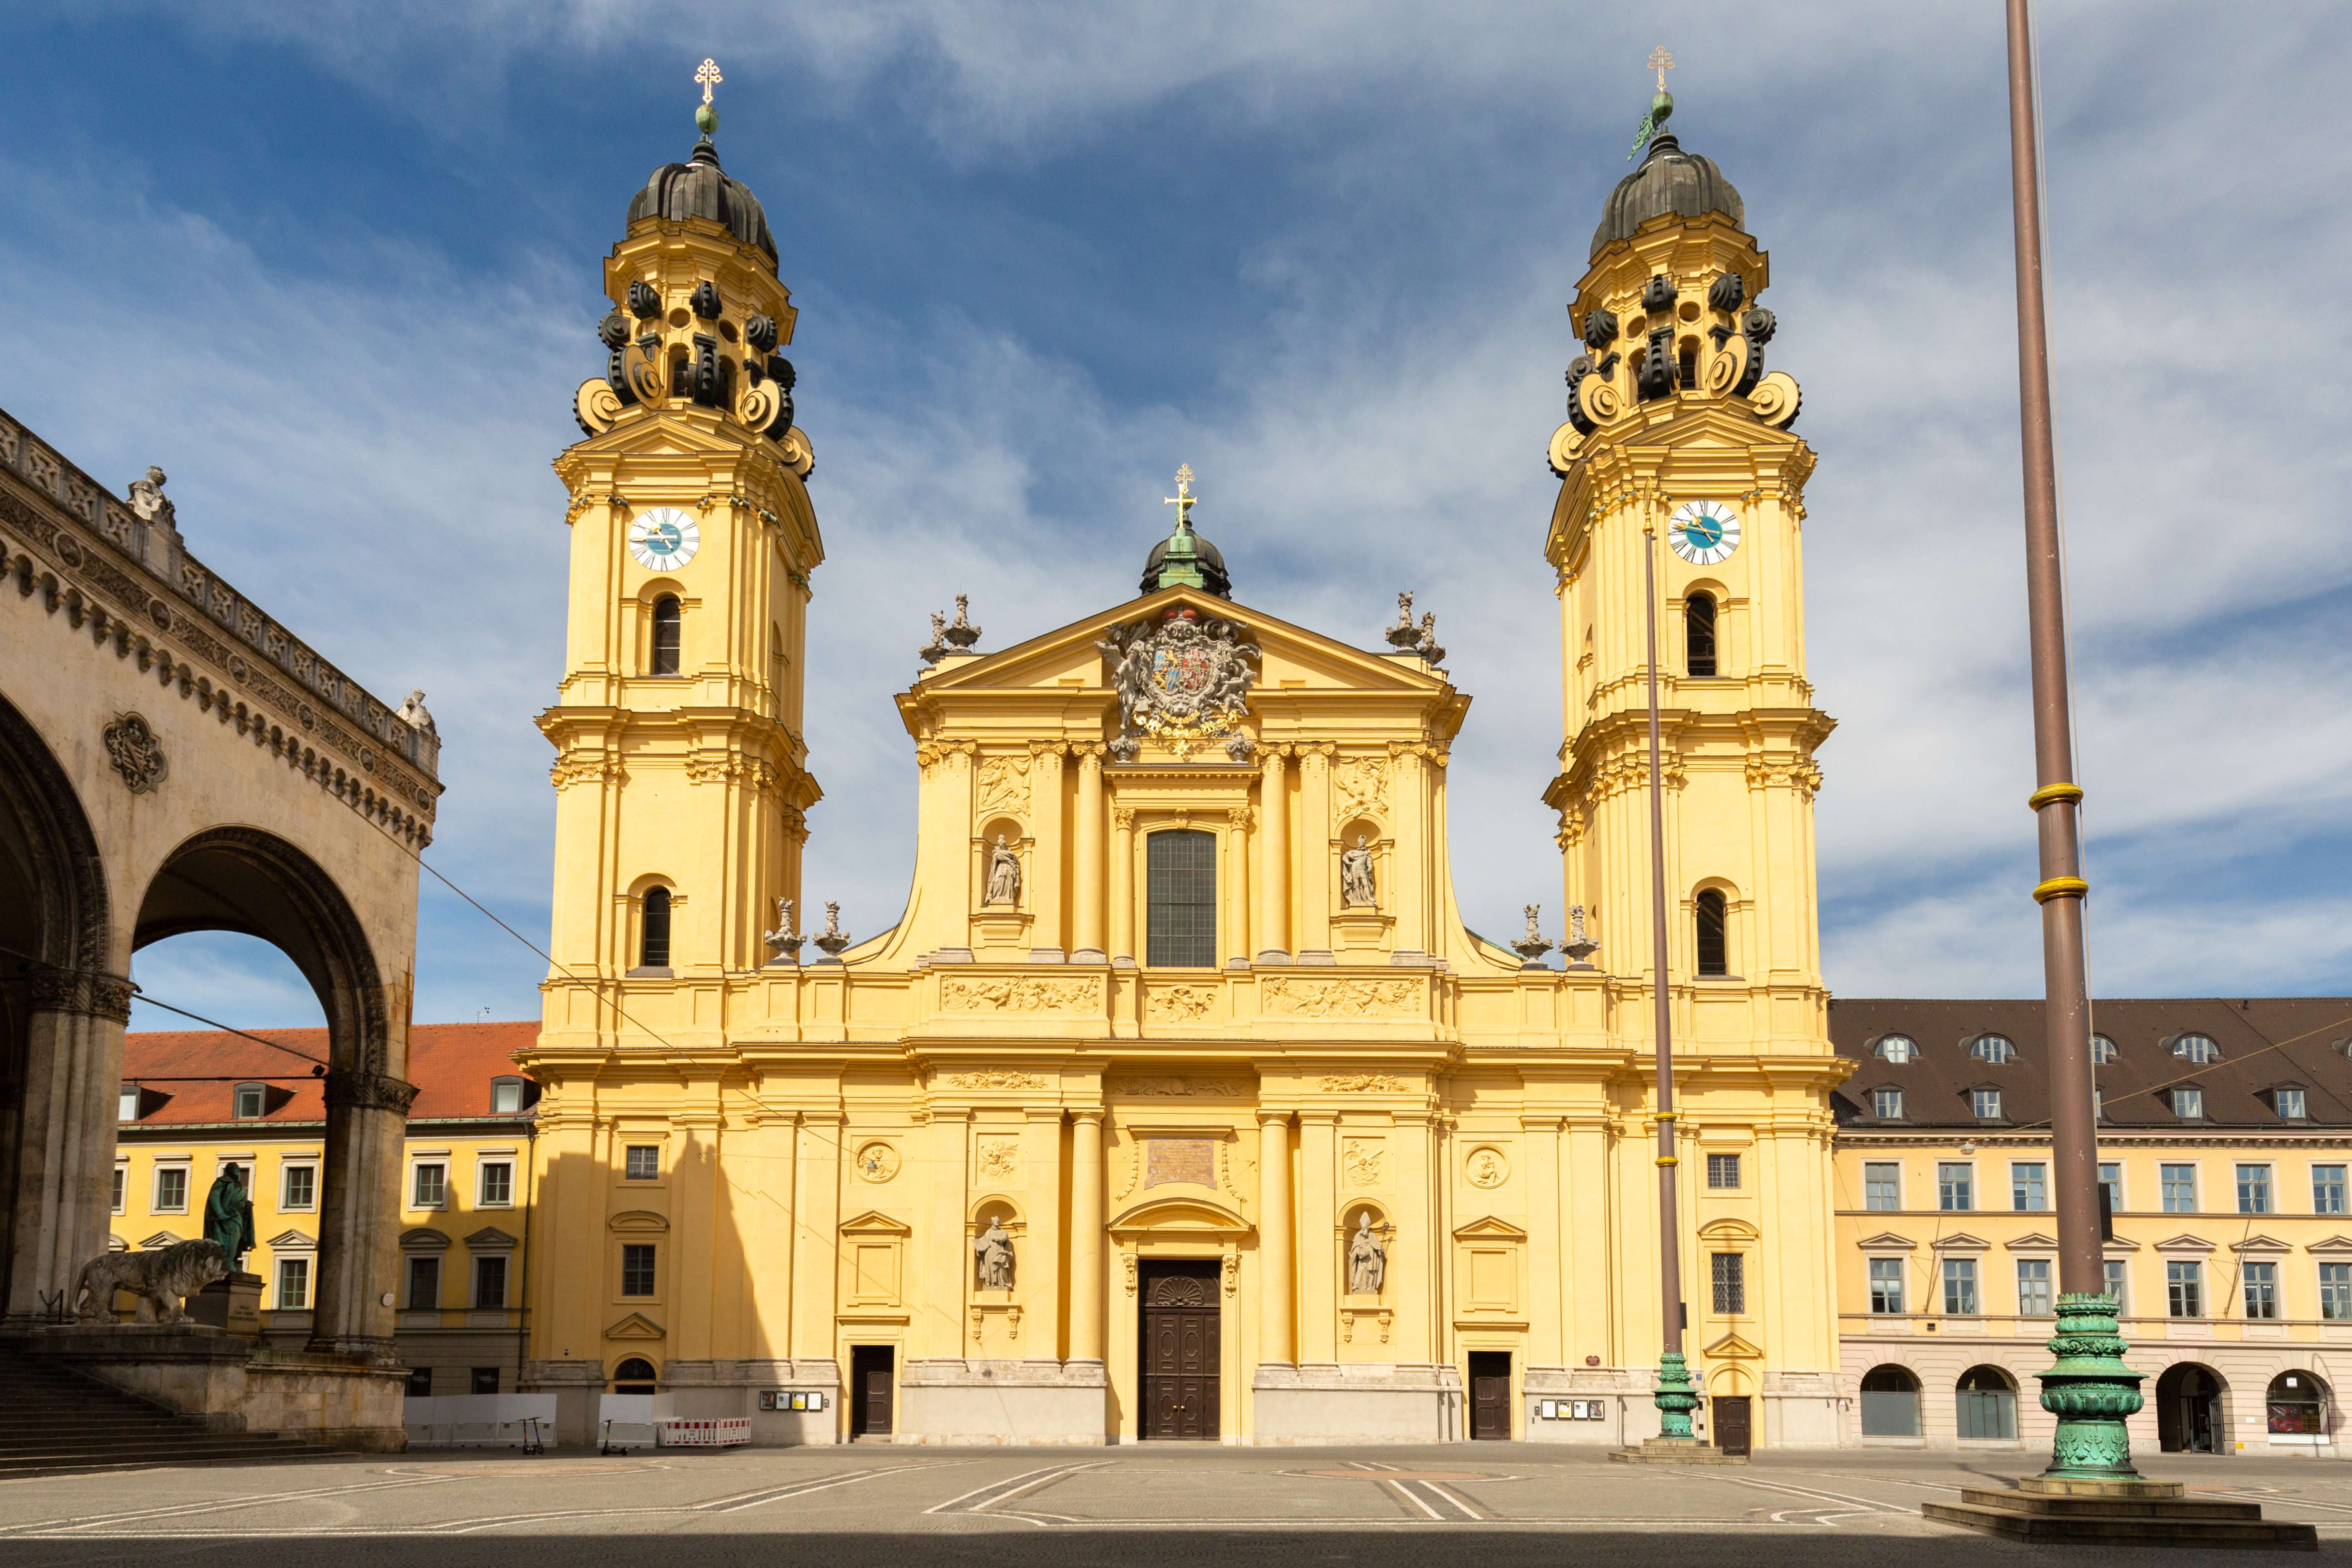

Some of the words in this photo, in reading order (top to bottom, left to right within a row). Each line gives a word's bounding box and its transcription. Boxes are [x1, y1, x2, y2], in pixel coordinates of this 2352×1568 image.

[661, 507, 670, 522] XII
[1683, 503, 1697, 517] XI
[1699, 500, 1708, 516] XII
[1713, 504, 1722, 518] I
[645, 510, 657, 523] XI
[674, 512, 684, 525] I
[1671, 514, 1690, 524] X
[1720, 514, 1737, 525] II
[633, 521, 650, 533] X
[680, 522, 697, 532] II
[673, 554, 685, 567] V
[1714, 546, 1726, 562] V
